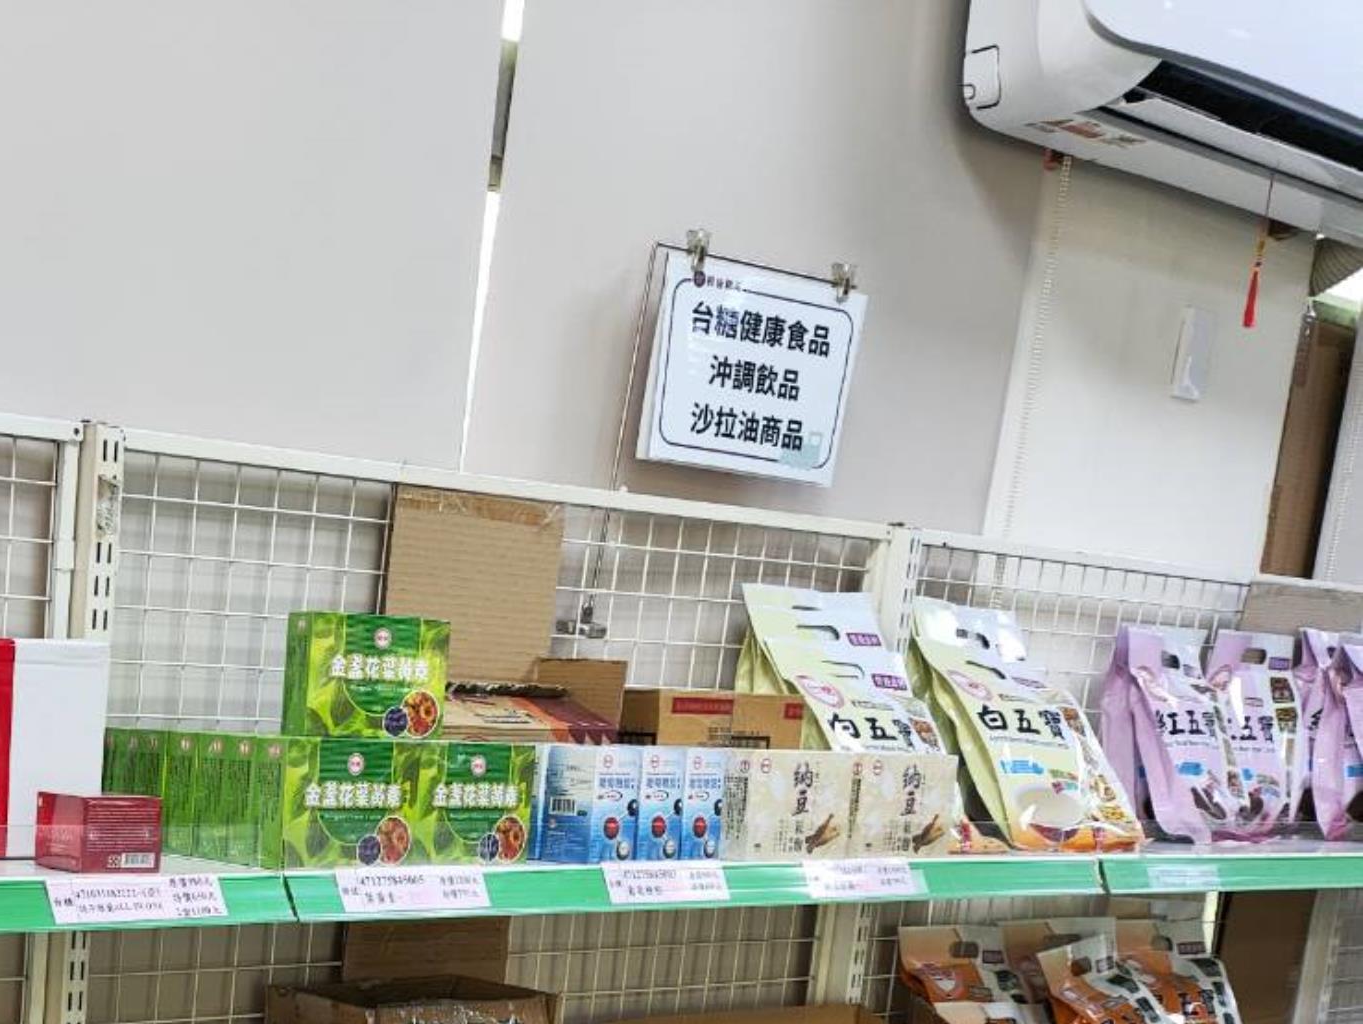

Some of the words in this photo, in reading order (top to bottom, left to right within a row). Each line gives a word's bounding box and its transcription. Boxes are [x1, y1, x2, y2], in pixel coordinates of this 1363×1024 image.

[691, 300, 831, 358] 台糖健康食品
[708, 354, 801, 402] 沖調飲品
[690, 402, 804, 451] 沙拉油商品
[977, 703, 1066, 740] 白五寶
